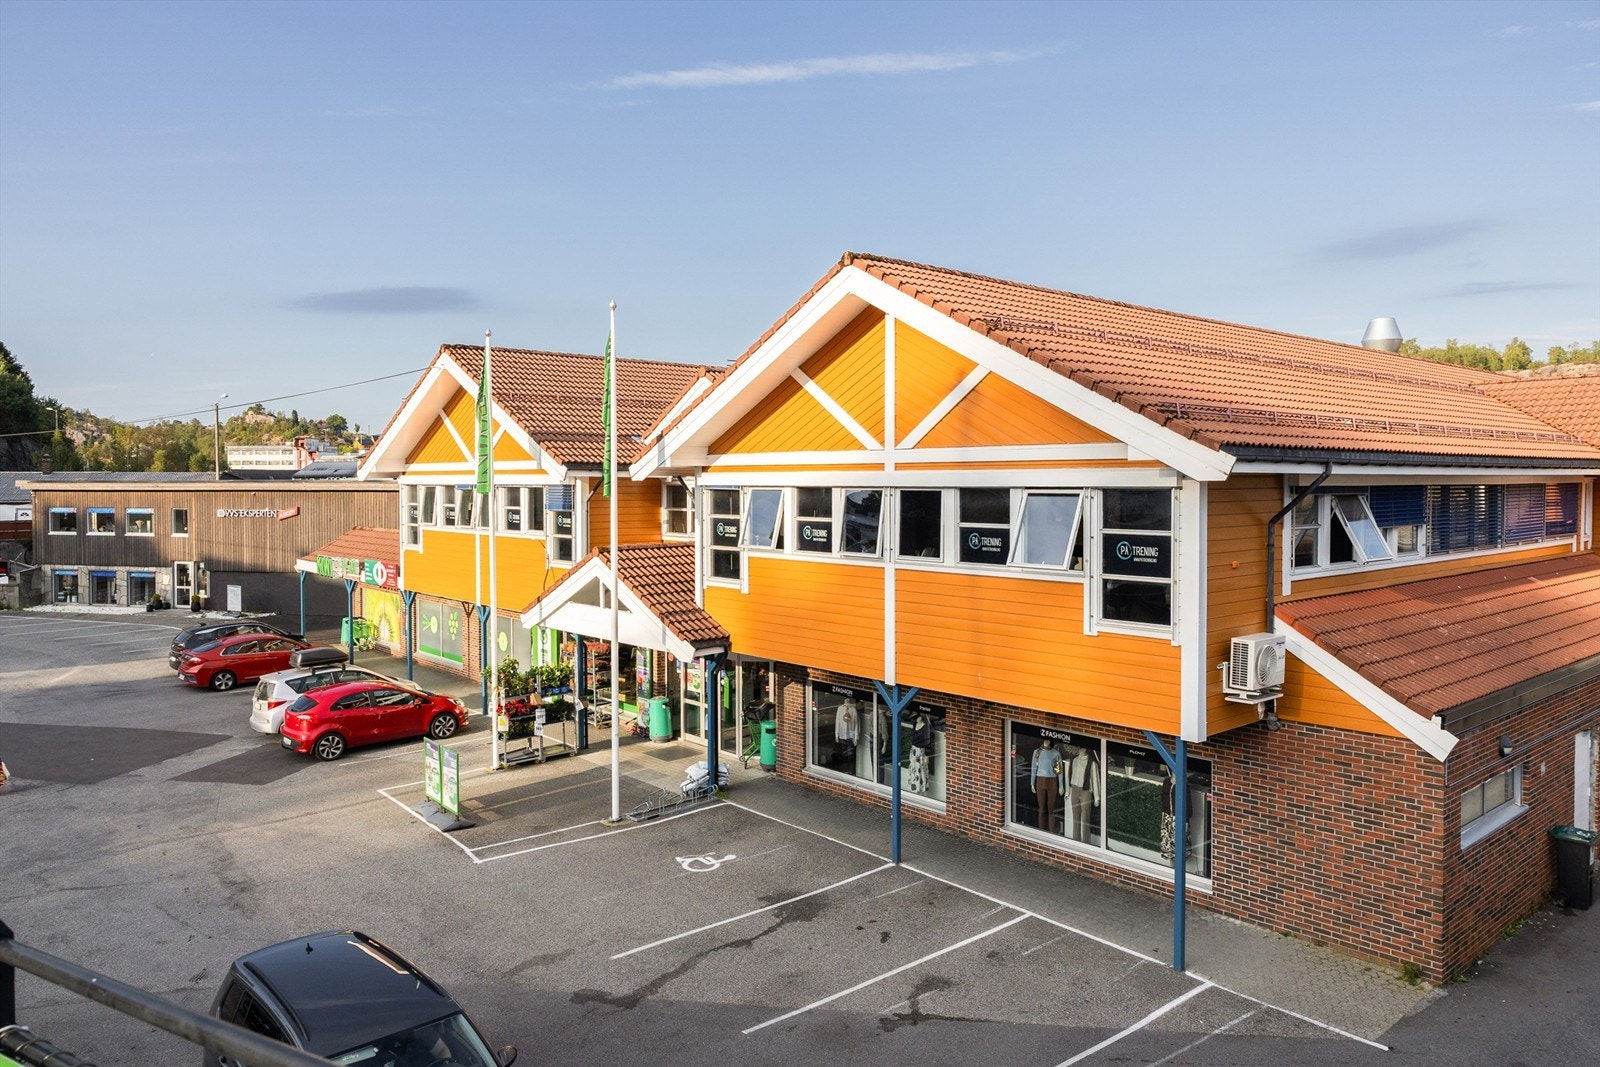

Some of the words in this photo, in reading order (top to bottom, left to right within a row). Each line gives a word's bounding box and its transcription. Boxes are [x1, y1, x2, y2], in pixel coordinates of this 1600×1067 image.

[812, 528, 828, 537] TRENING
[981, 536, 1002, 547] TRENING
[1132, 546, 1159, 557] TRENING
[1046, 730, 1071, 742] FASHION
